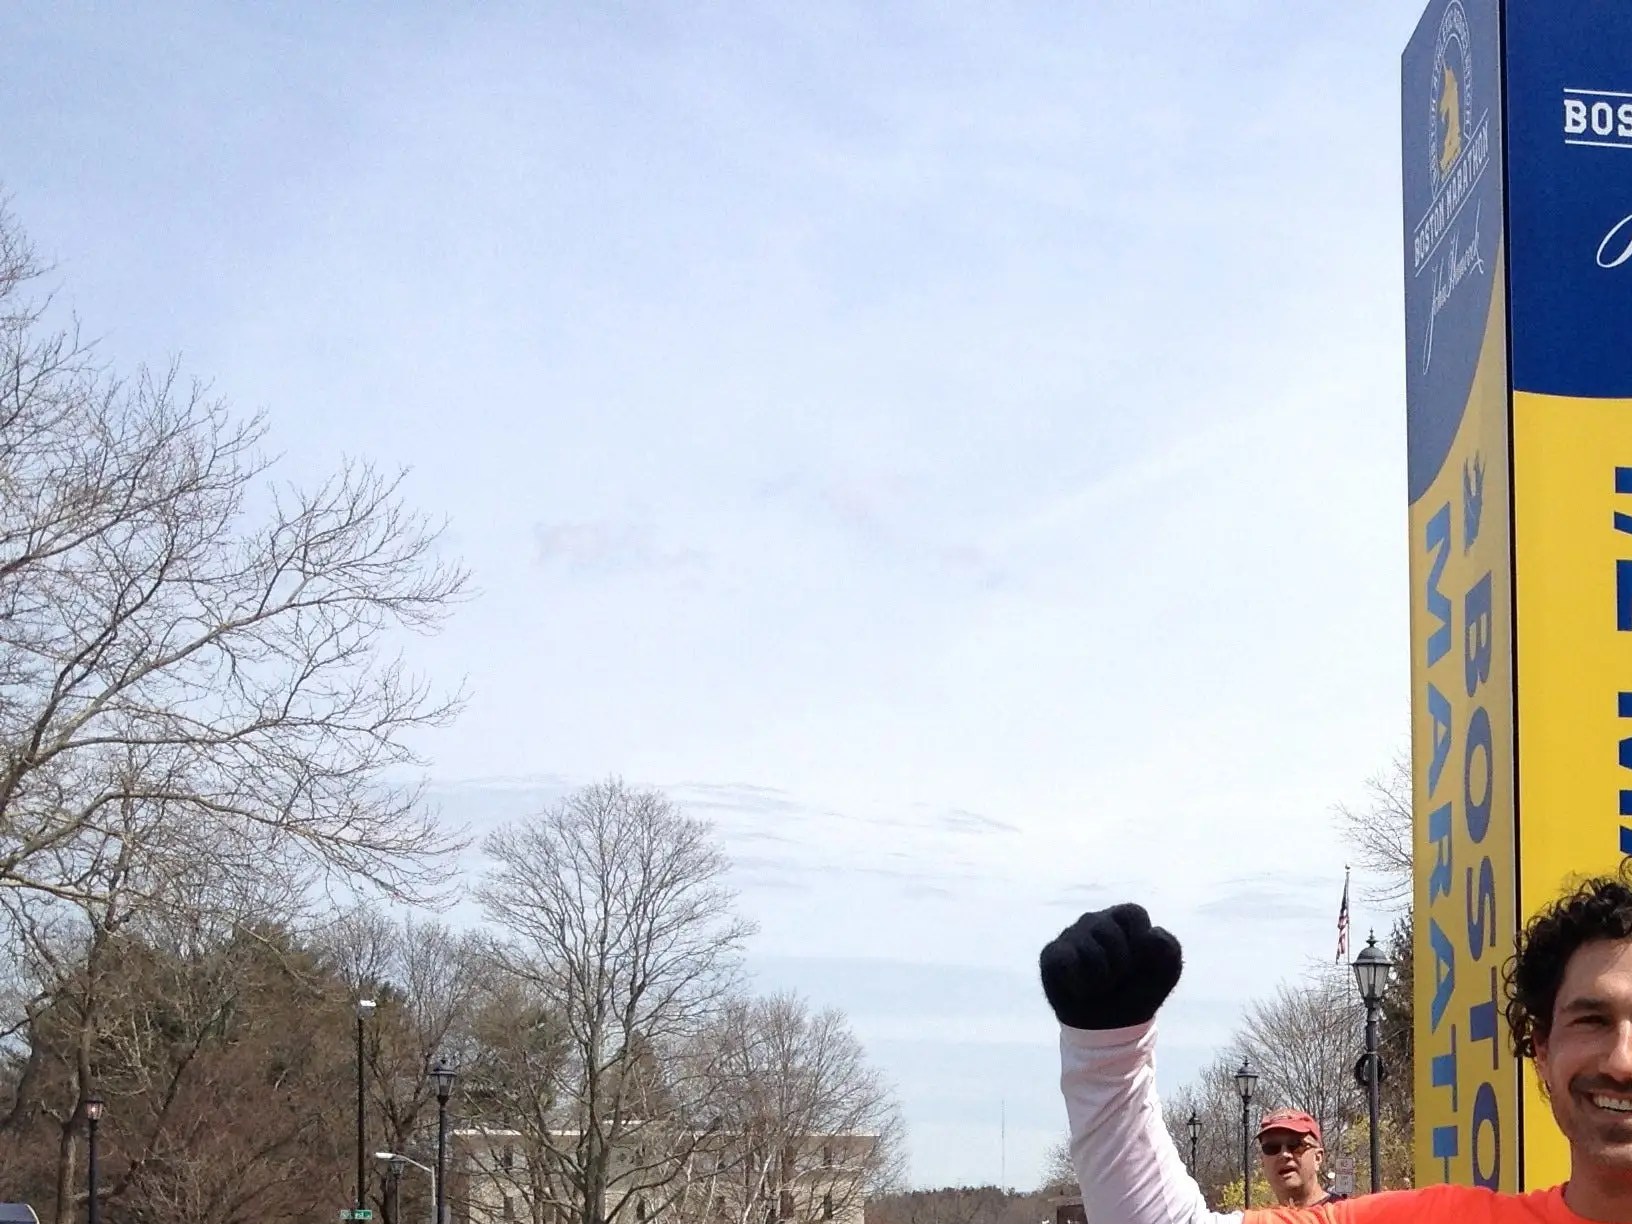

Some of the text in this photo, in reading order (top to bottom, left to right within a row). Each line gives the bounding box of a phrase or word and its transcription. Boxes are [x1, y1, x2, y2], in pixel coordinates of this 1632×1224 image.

[1413, 197, 1445, 268] BOSTON
[1446, 120, 1490, 219] MARATHON
[1425, 500, 1458, 1184] MARATH
[1464, 569, 1500, 1193] BOSTO
